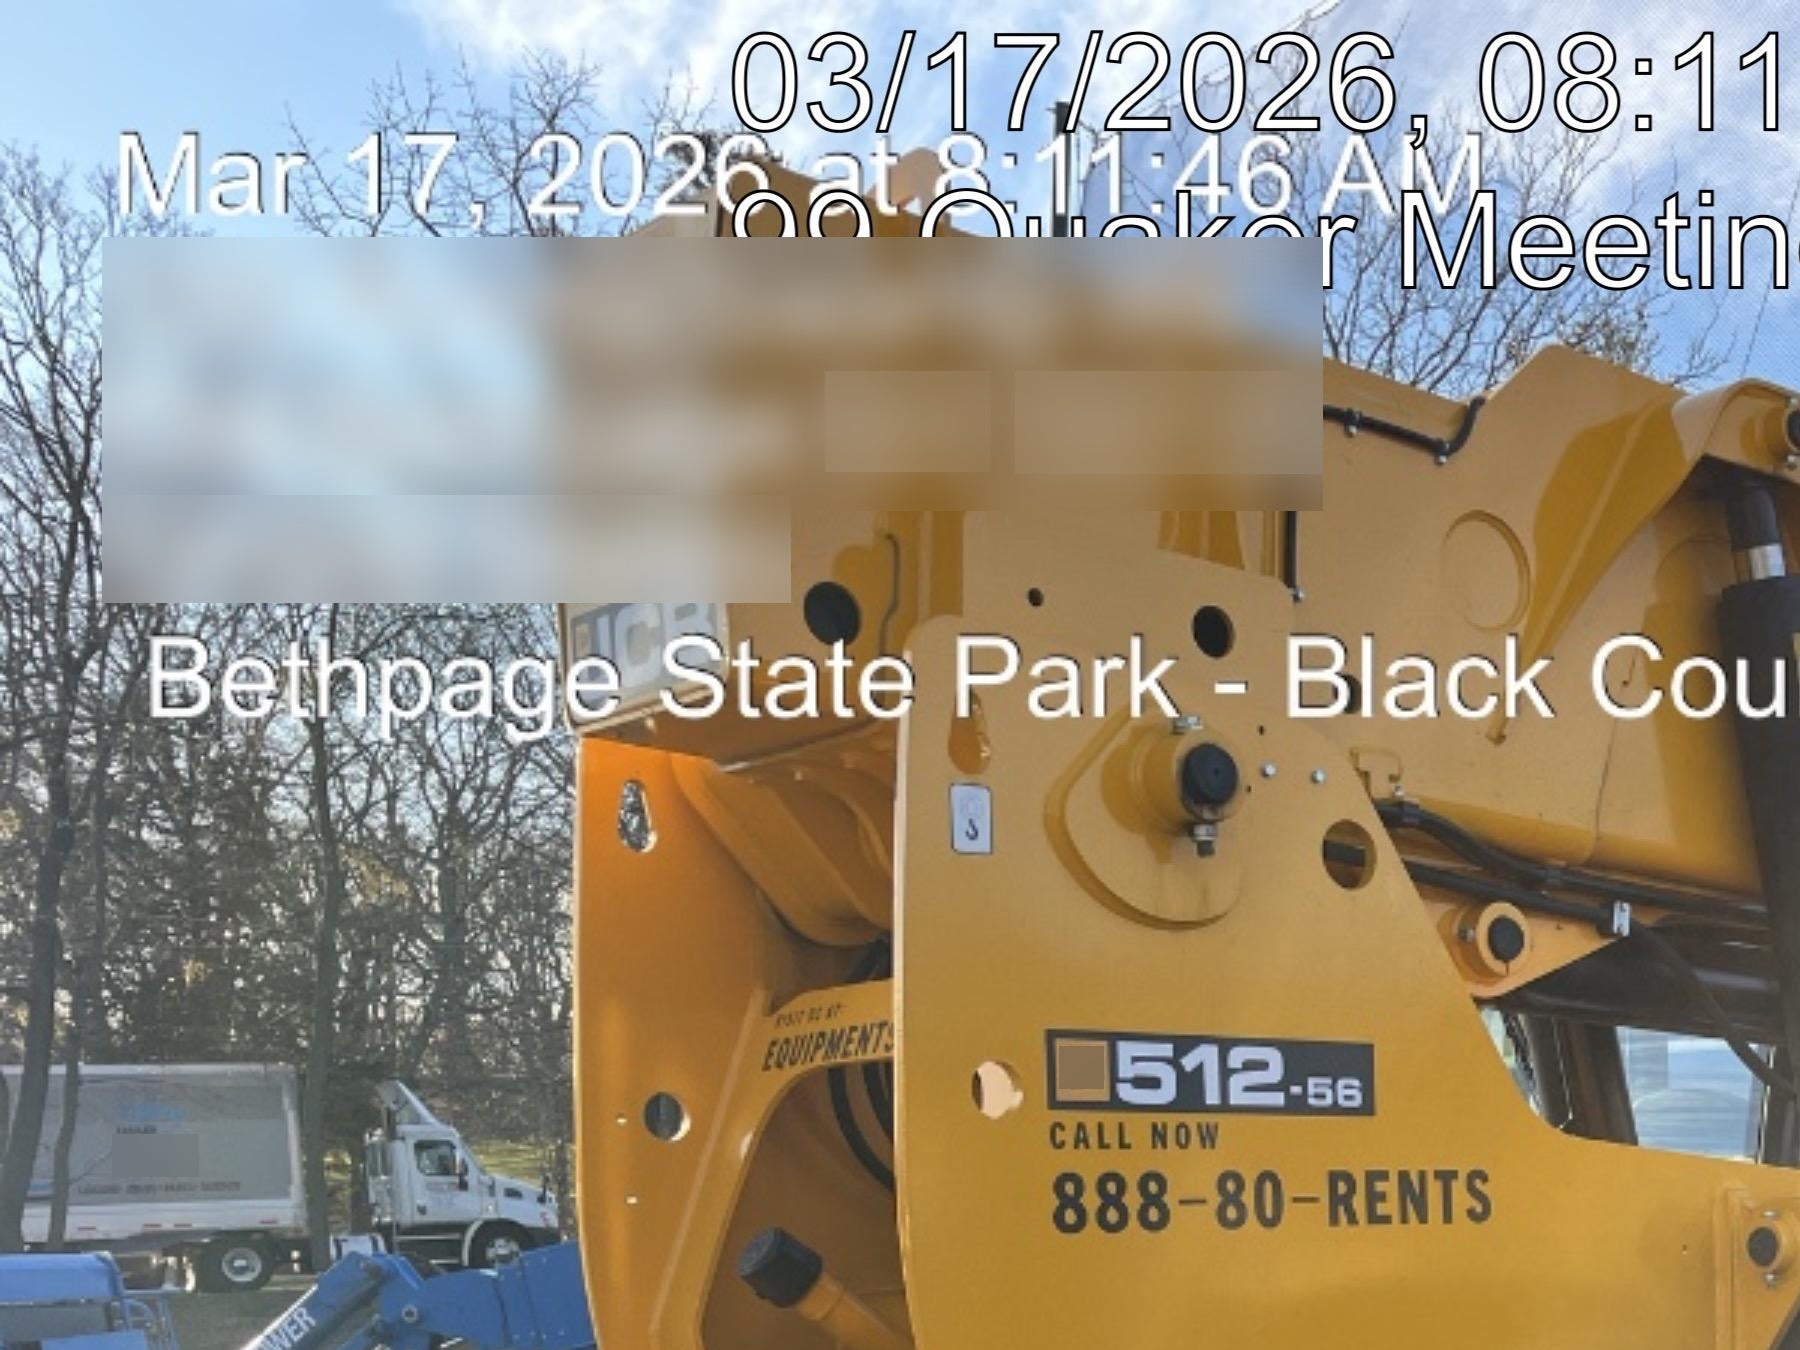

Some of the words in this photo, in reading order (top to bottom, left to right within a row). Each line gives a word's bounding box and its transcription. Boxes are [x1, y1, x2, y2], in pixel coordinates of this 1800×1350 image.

[1049, 1122, 1132, 1151] CALL
[1151, 1122, 1219, 1151] NOW
[1052, 1168, 1493, 1235] 888-80-RENTS
